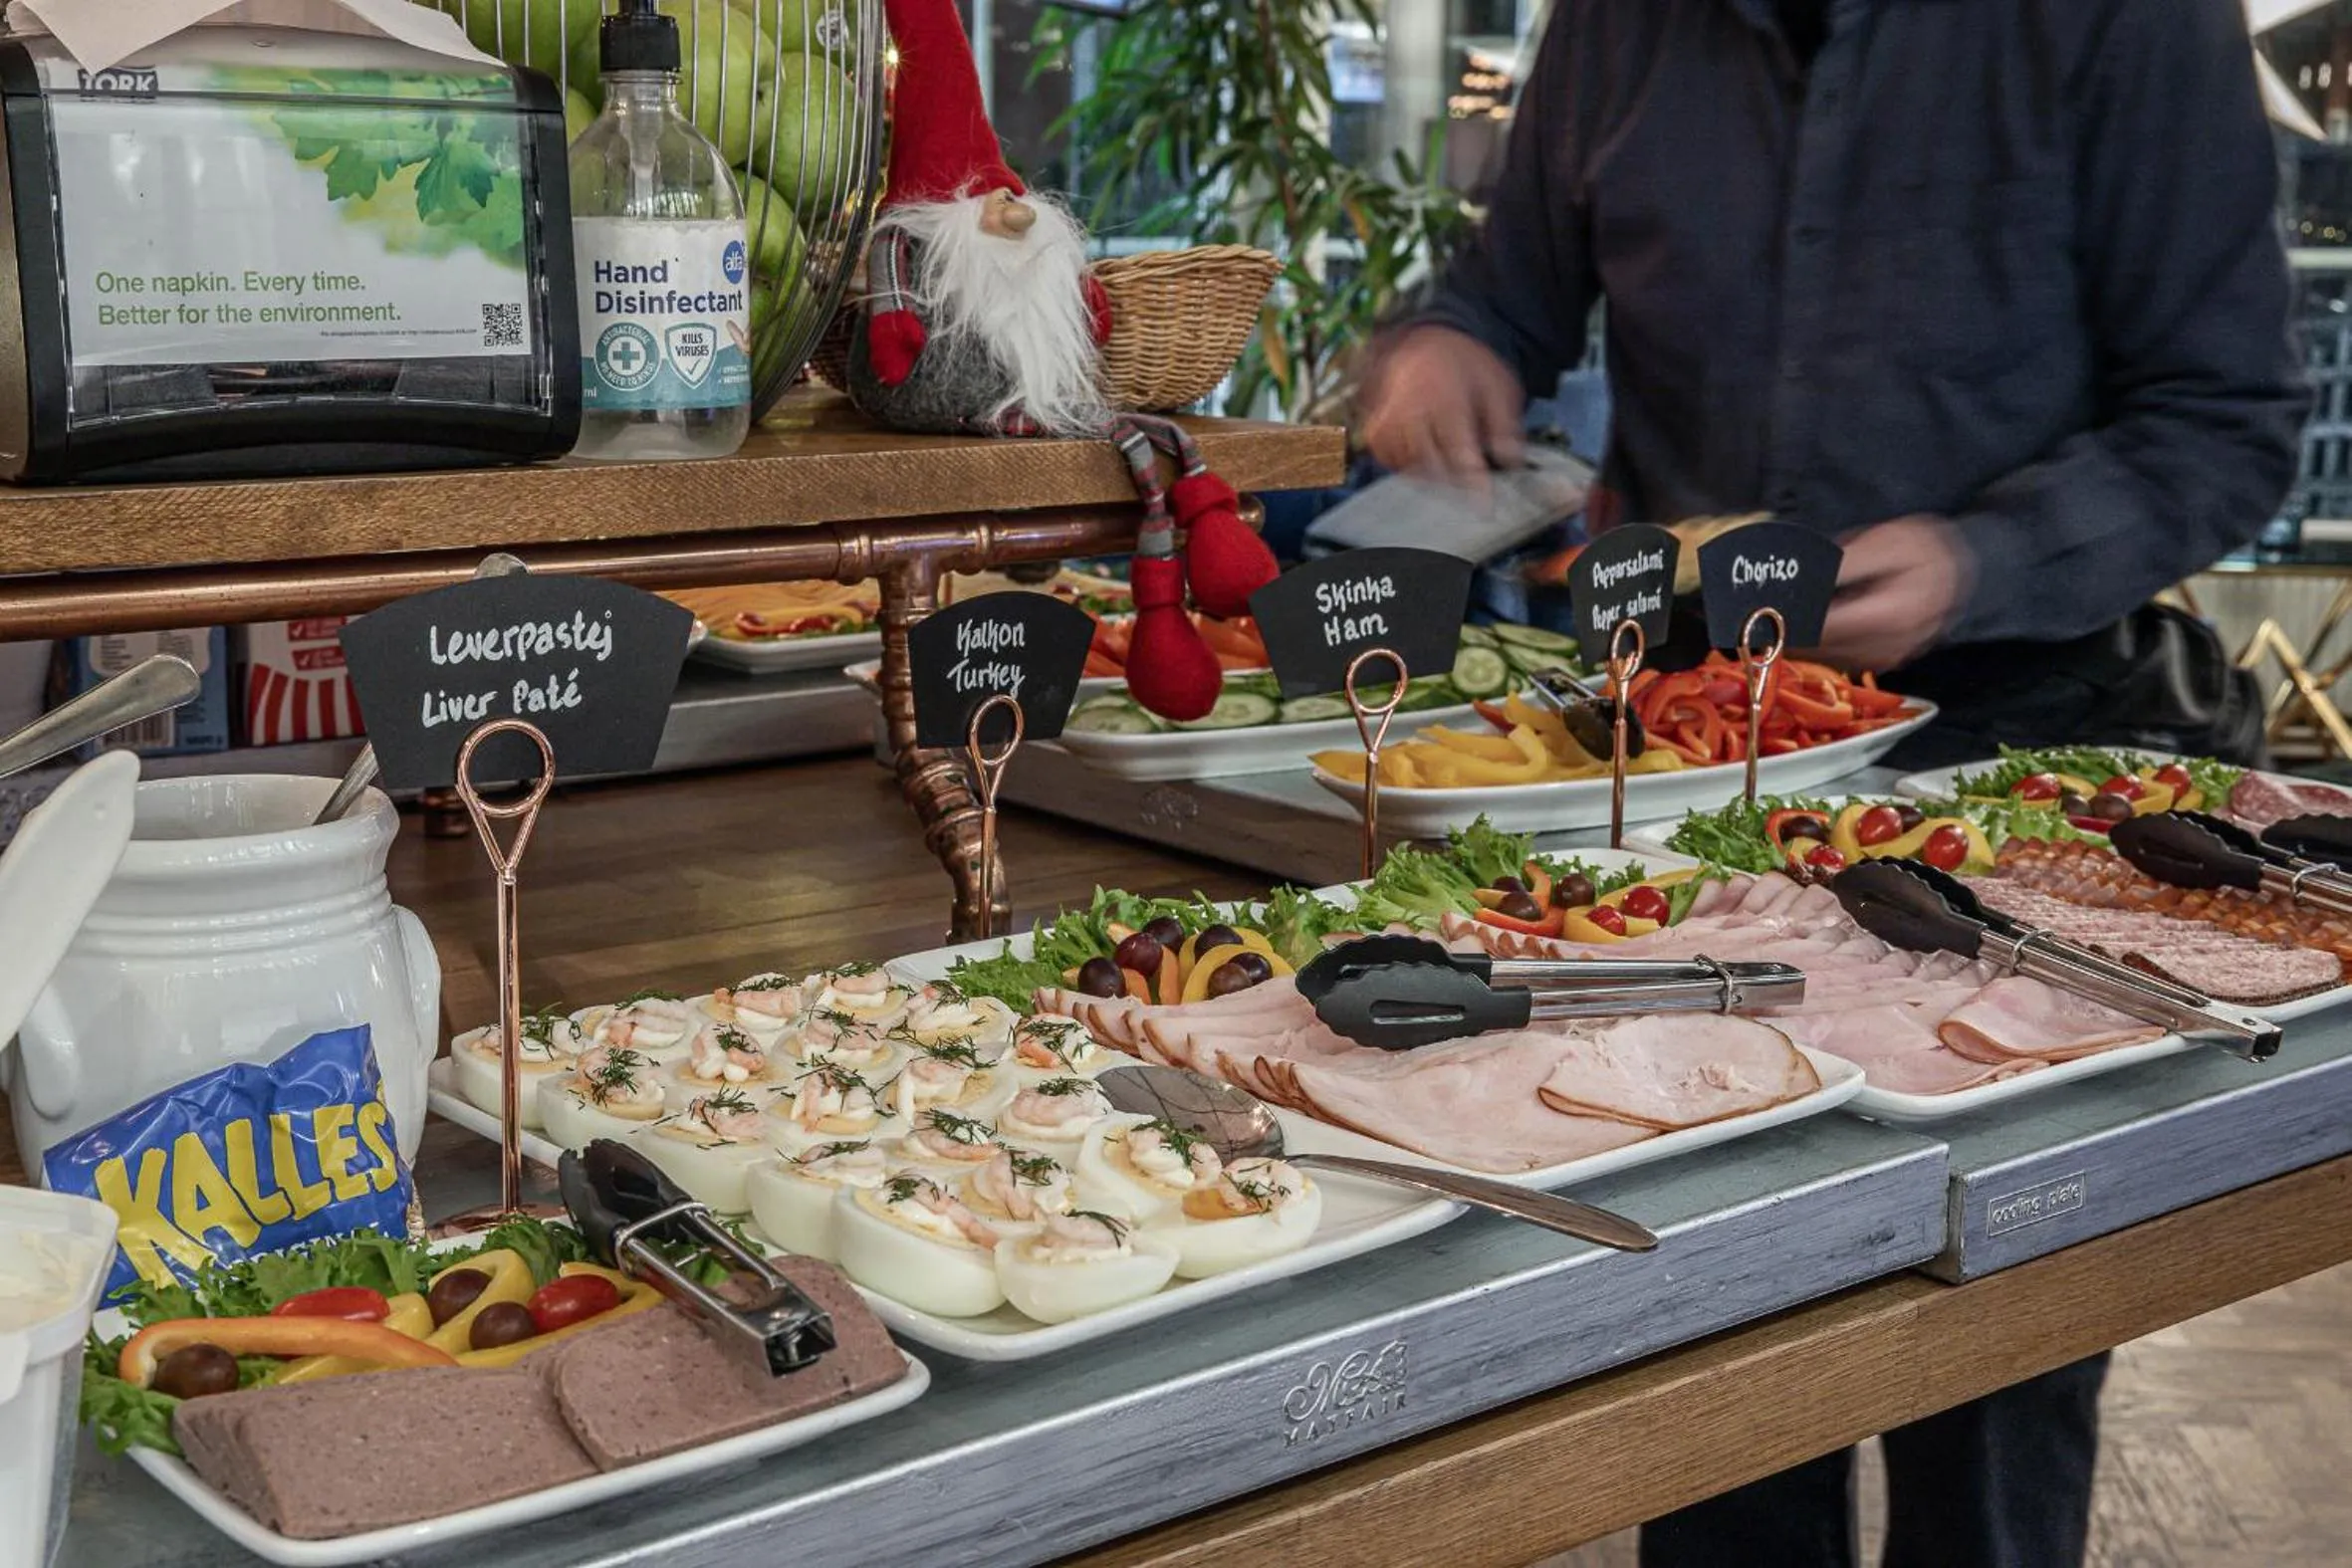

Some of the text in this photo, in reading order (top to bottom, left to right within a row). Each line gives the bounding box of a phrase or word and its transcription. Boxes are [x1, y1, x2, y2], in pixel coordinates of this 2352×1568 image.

[96, 271, 365, 296] One napkin. Every time.
[594, 259, 668, 283] Hand
[99, 302, 401, 325] Better for the environment.
[595, 290, 743, 314] Disinfectant
[675, 344, 709, 356] VIRUSES
[681, 333, 703, 344] KILLS
[1315, 575, 1396, 613] Skinka
[430, 609, 612, 665] Leverpastej
[957, 618, 1025, 657] Kalkon
[1324, 613, 1389, 646] Ham
[422, 667, 583, 728] Liver Paté
[946, 658, 1026, 701] Turkey
[95, 1100, 397, 1291] KALLES
[1993, 1183, 2080, 1224] cooling plate
[1283, 1392, 1407, 1449] MAYFAIR
